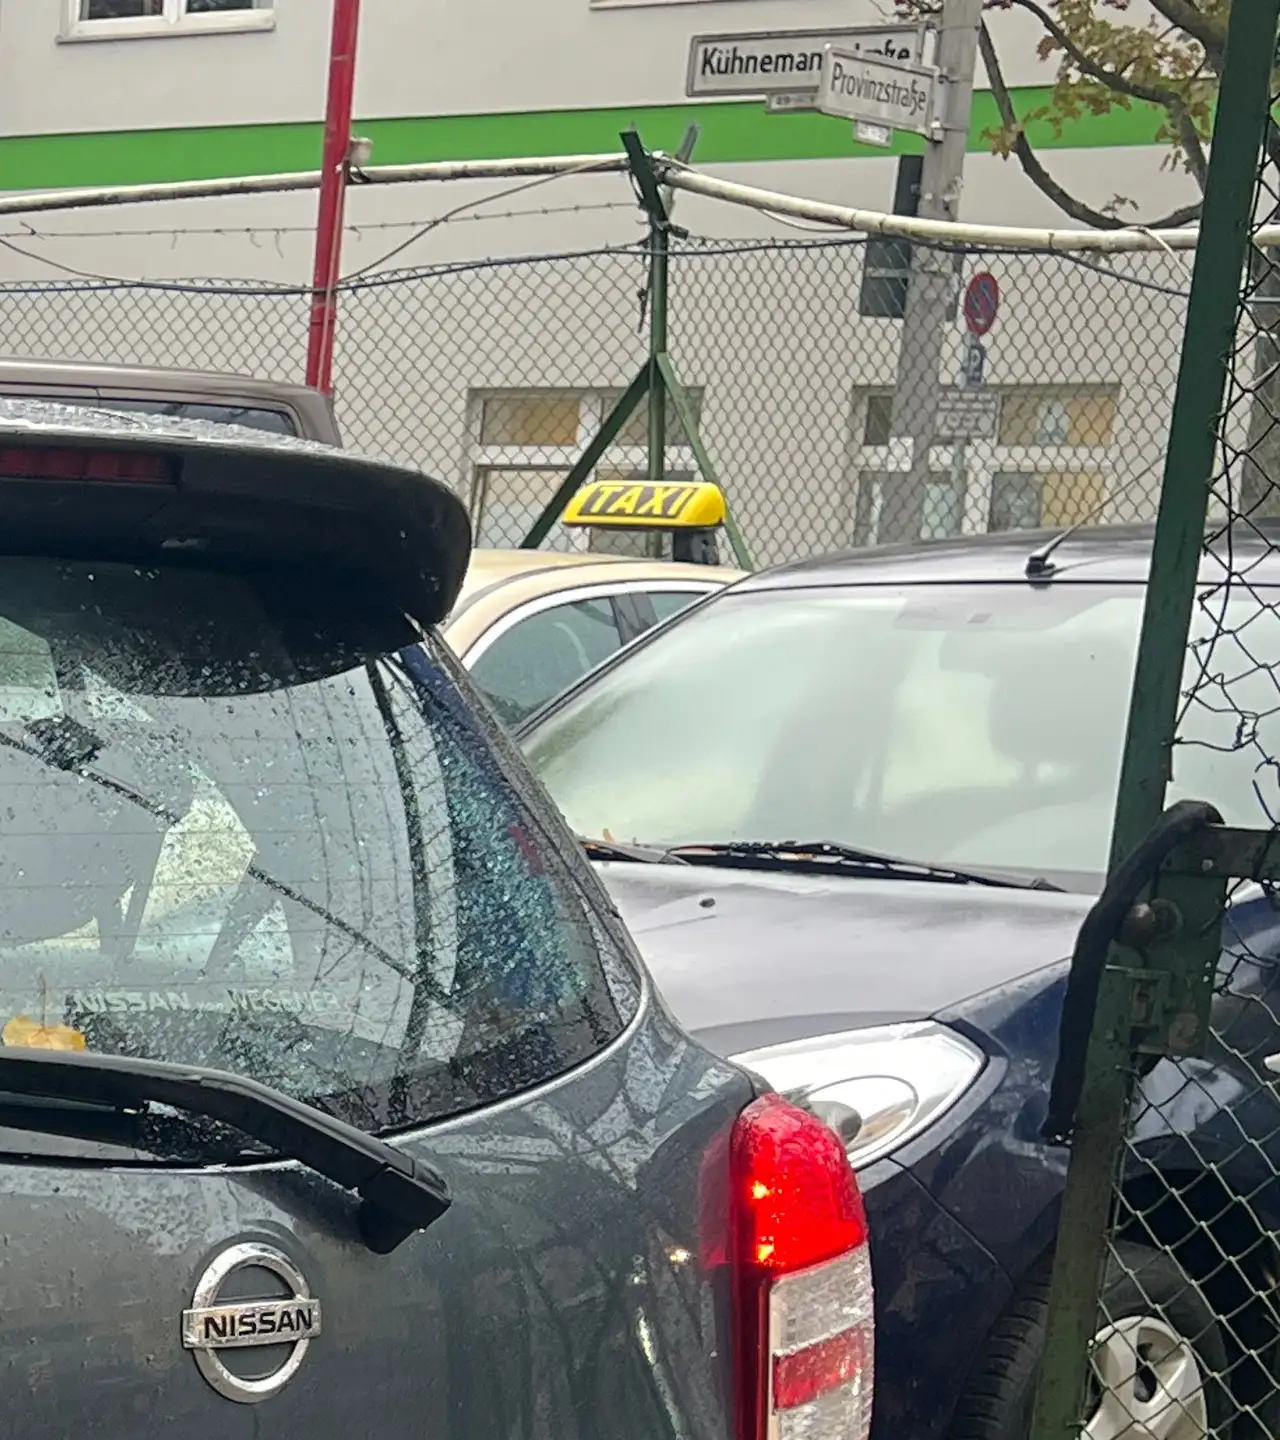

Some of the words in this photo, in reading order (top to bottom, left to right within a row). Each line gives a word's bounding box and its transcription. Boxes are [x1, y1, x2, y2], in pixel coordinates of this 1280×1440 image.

[831, 61, 927, 116] Provinzstraße
[589, 485, 691, 516] TAXI
[74, 989, 192, 1013] NISSAN
[203, 1308, 313, 1340] NISSAN
